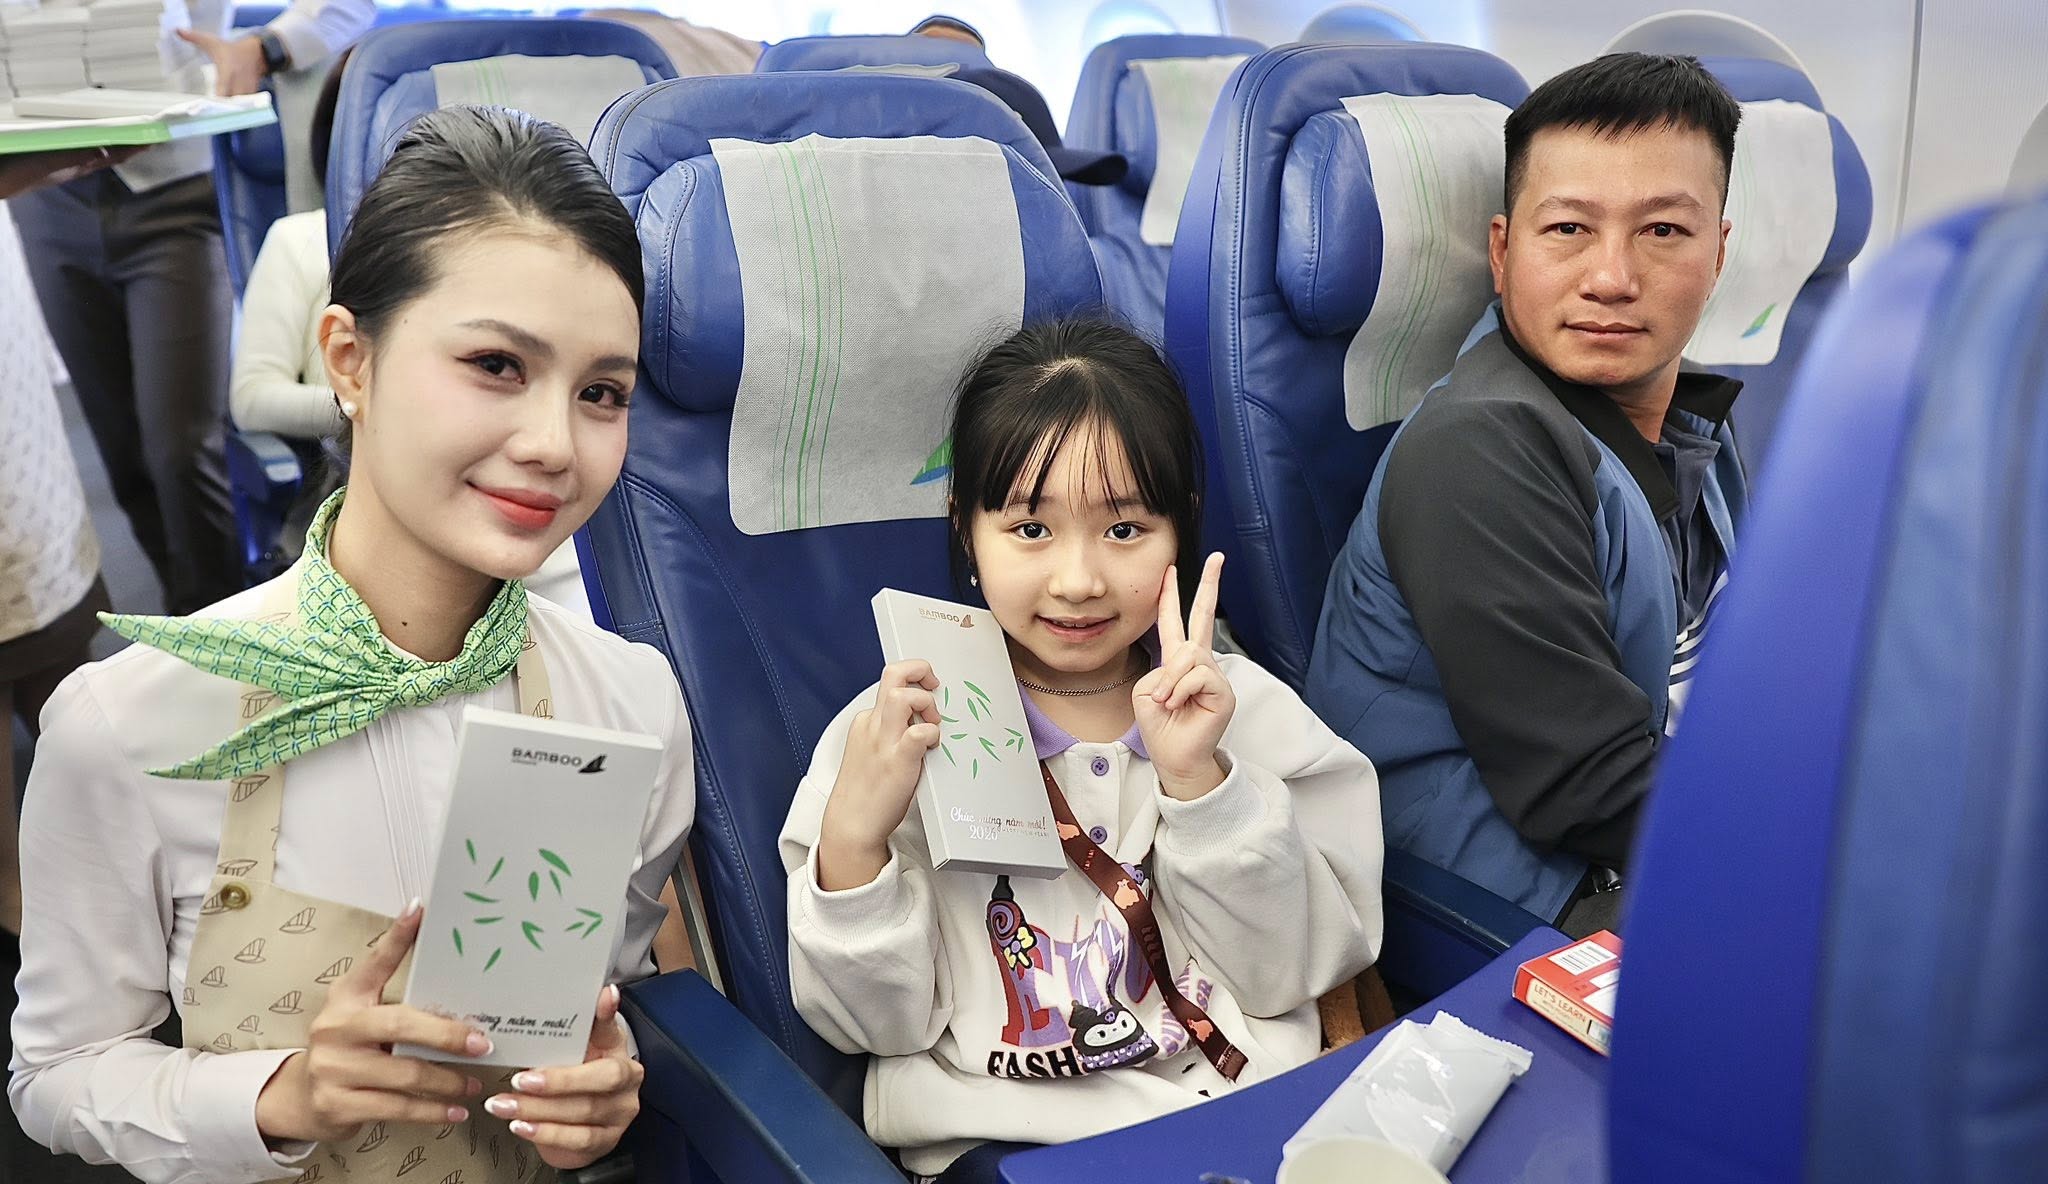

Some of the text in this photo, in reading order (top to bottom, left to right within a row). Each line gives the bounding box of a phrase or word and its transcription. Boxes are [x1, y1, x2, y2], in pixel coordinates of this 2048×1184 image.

[918, 607, 960, 623] BAMBOO
[511, 747, 582, 768] BAMBOO
[1534, 984, 1556, 1004] LET'S
[1558, 1001, 1587, 1023] LEARN
[526, 1029, 546, 1038] NEW
[987, 1046, 1086, 1080] FASH
